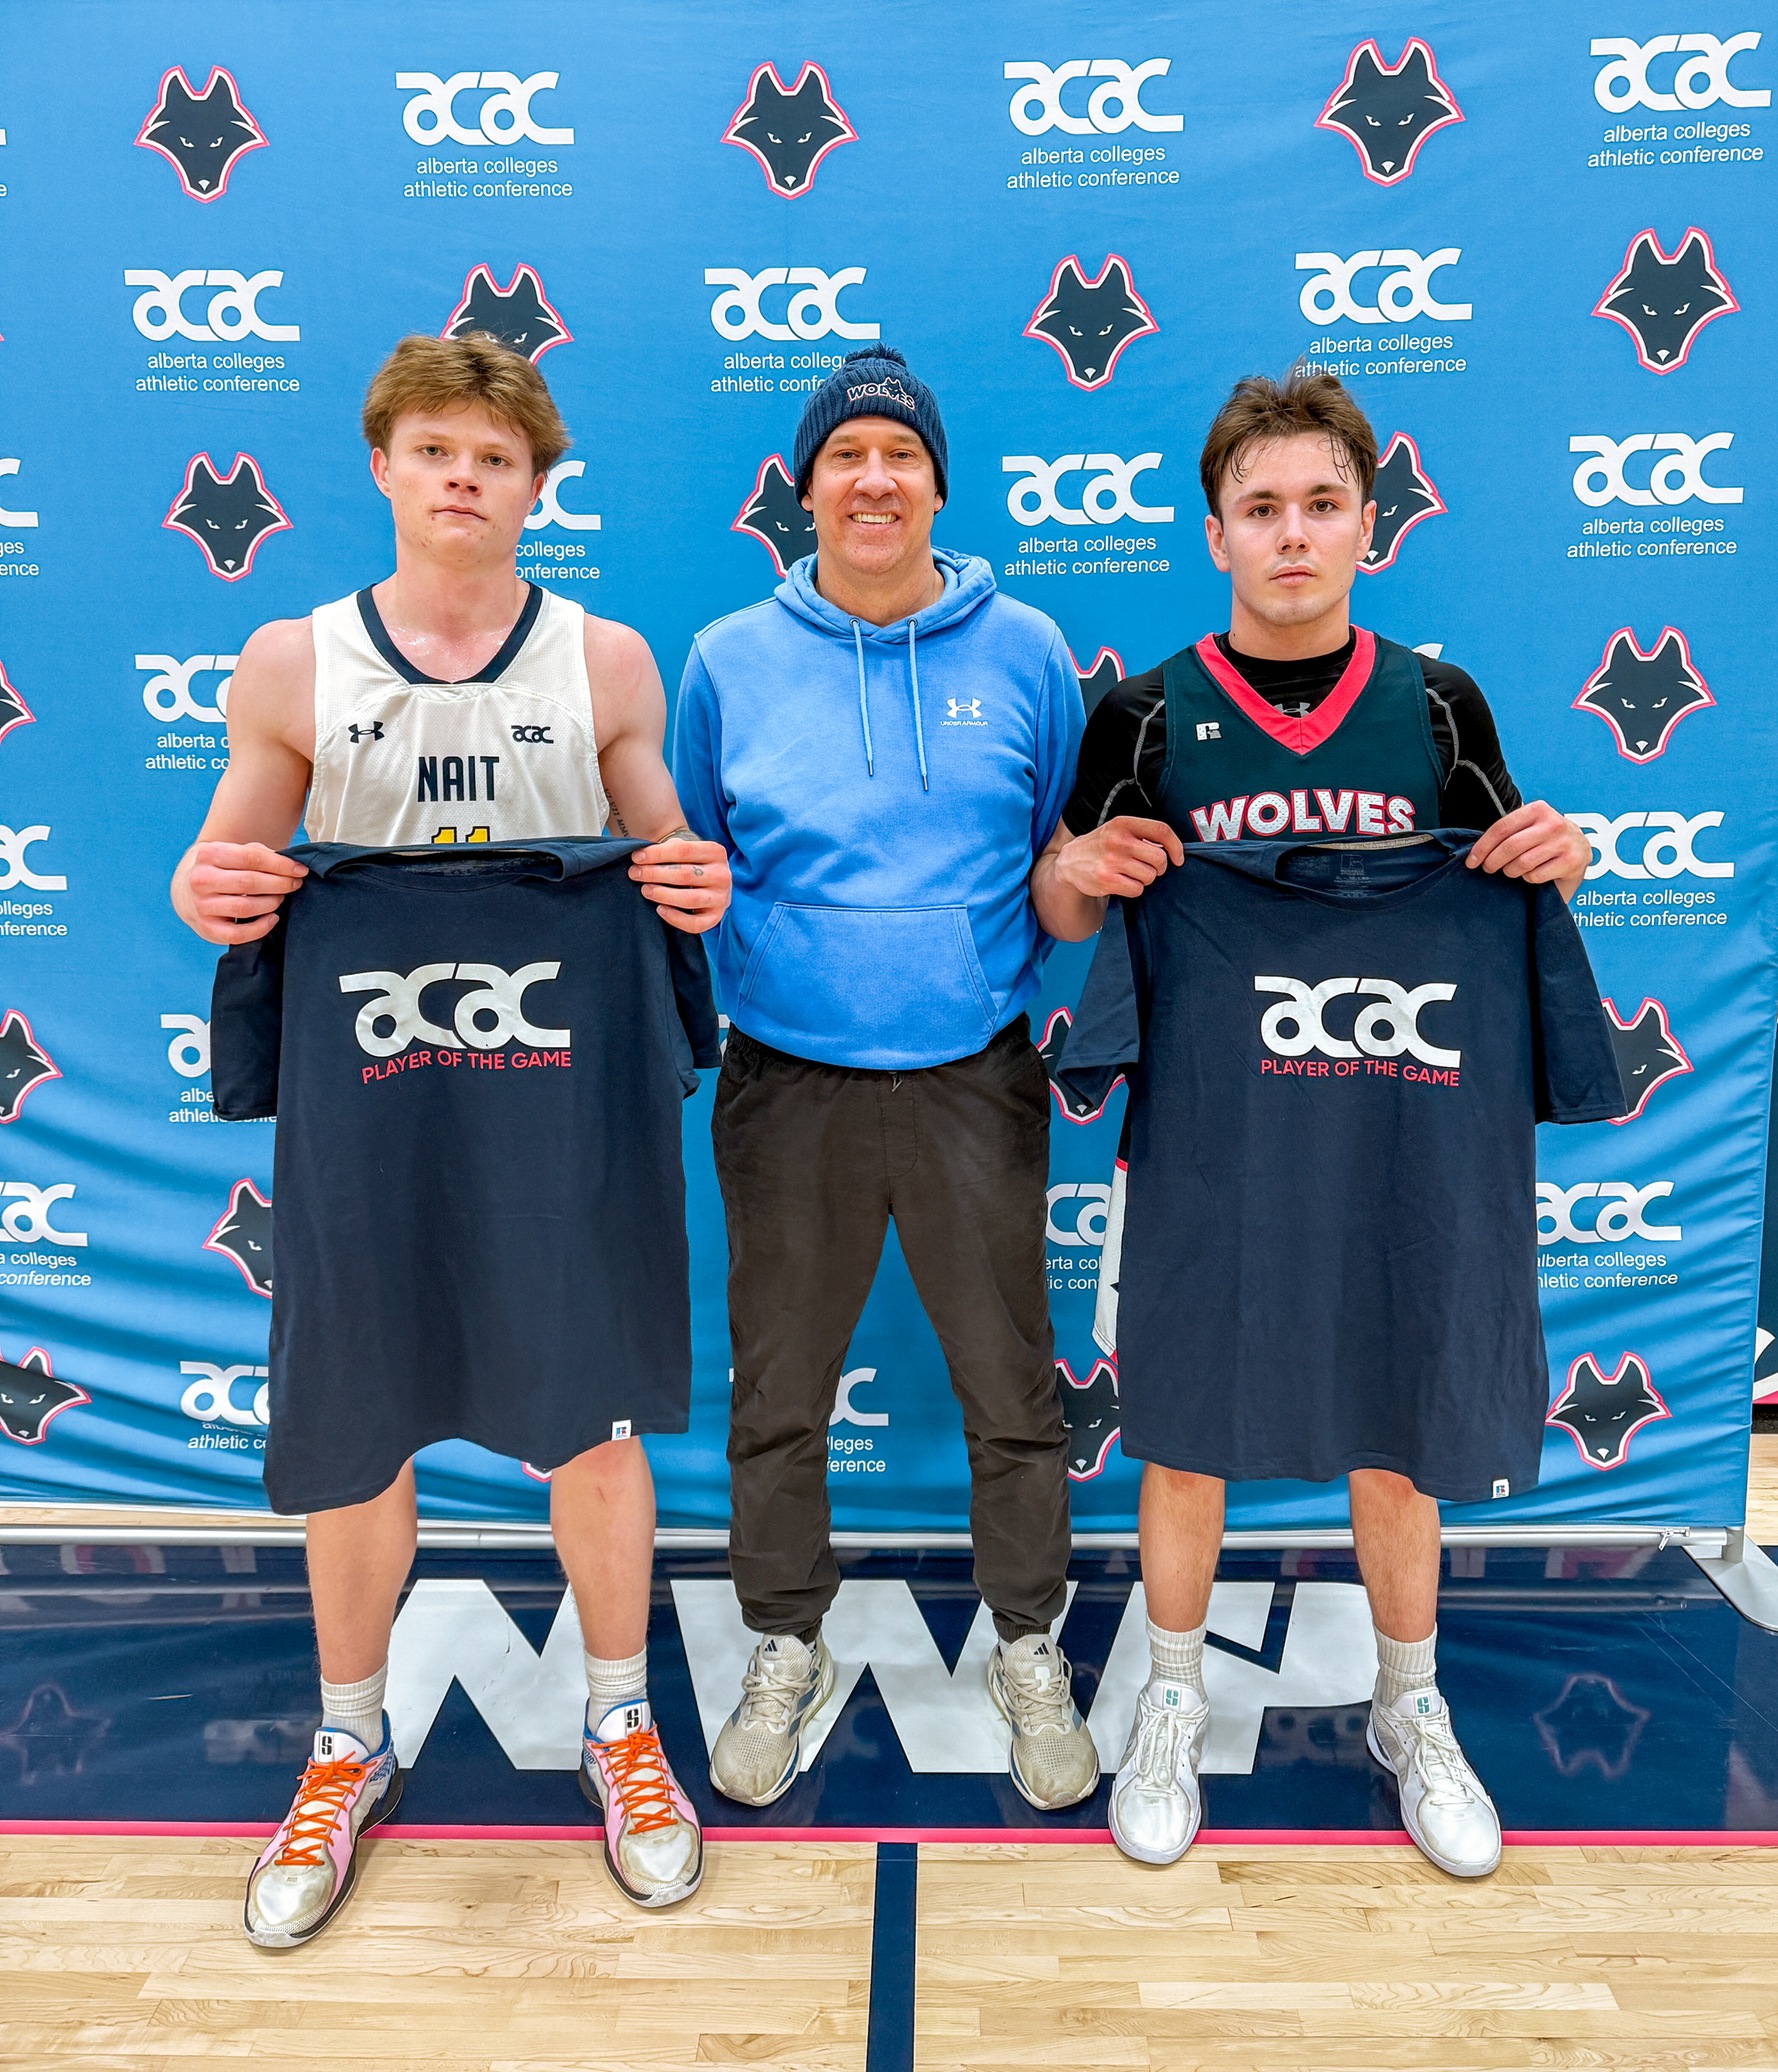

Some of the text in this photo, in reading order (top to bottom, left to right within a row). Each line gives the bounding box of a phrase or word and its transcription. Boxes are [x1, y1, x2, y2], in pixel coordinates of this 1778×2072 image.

[1590, 31, 1772, 113] acac
[1004, 58, 1184, 136] acac
[395, 71, 575, 146] acac
[1603, 121, 1751, 143] alberta colleges
[1021, 145, 1166, 166] alberta colleges
[1587, 145, 1764, 167] athletic conference
[416, 156, 558, 178] alberta colleges
[403, 180, 573, 197] athletic conference
[1007, 168, 1180, 189] athletic conference
[1295, 247, 1473, 326] acac
[124, 269, 301, 342] acac
[704, 266, 881, 341] acac
[1309, 333, 1453, 354] alberta colleges
[147, 352, 285, 373] alberta colleges
[724, 352, 846, 372] alberta colleg
[1365, 357, 1467, 375] conference
[135, 375, 300, 392] athletic conference
[710, 375, 774, 392] athletic
[1569, 432, 1744, 507] acac
[1002, 452, 1175, 527] acac
[1582, 516, 1724, 536] alberta colleges
[515, 541, 586, 561] colleges
[1018, 535, 1157, 555] alberta colleges
[1567, 539, 1737, 558] athletic conference
[515, 563, 600, 579] onference
[1004, 557, 1170, 576] athletic conference
[157, 732, 216, 749] alberta
[511, 725, 554, 744] acac
[145, 754, 206, 770] athletic
[417, 755, 500, 802] NAIT
[1189, 788, 1416, 843] WOLVES
[1576, 889, 1716, 908] alberta colleges
[0, 900, 53, 919] lleges
[1574, 910, 1727, 927] thletic conference
[0, 921, 67, 936] ference
[338, 961, 571, 1058] acac
[1254, 975, 1461, 1069] acac
[361, 1049, 572, 1085] PLAYER OF THE GAME
[1260, 1059, 1461, 1087] PLAYER OF THE GAME
[180, 1087, 214, 1103] albe
[10, 1251, 77, 1270] colleges
[1594, 1251, 1667, 1271] colleges
[1584, 1272, 1678, 1288] conference
[187, 1434, 249, 1449] athletic
[827, 1435, 874, 1455] leges
[827, 1456, 886, 1473] erence
